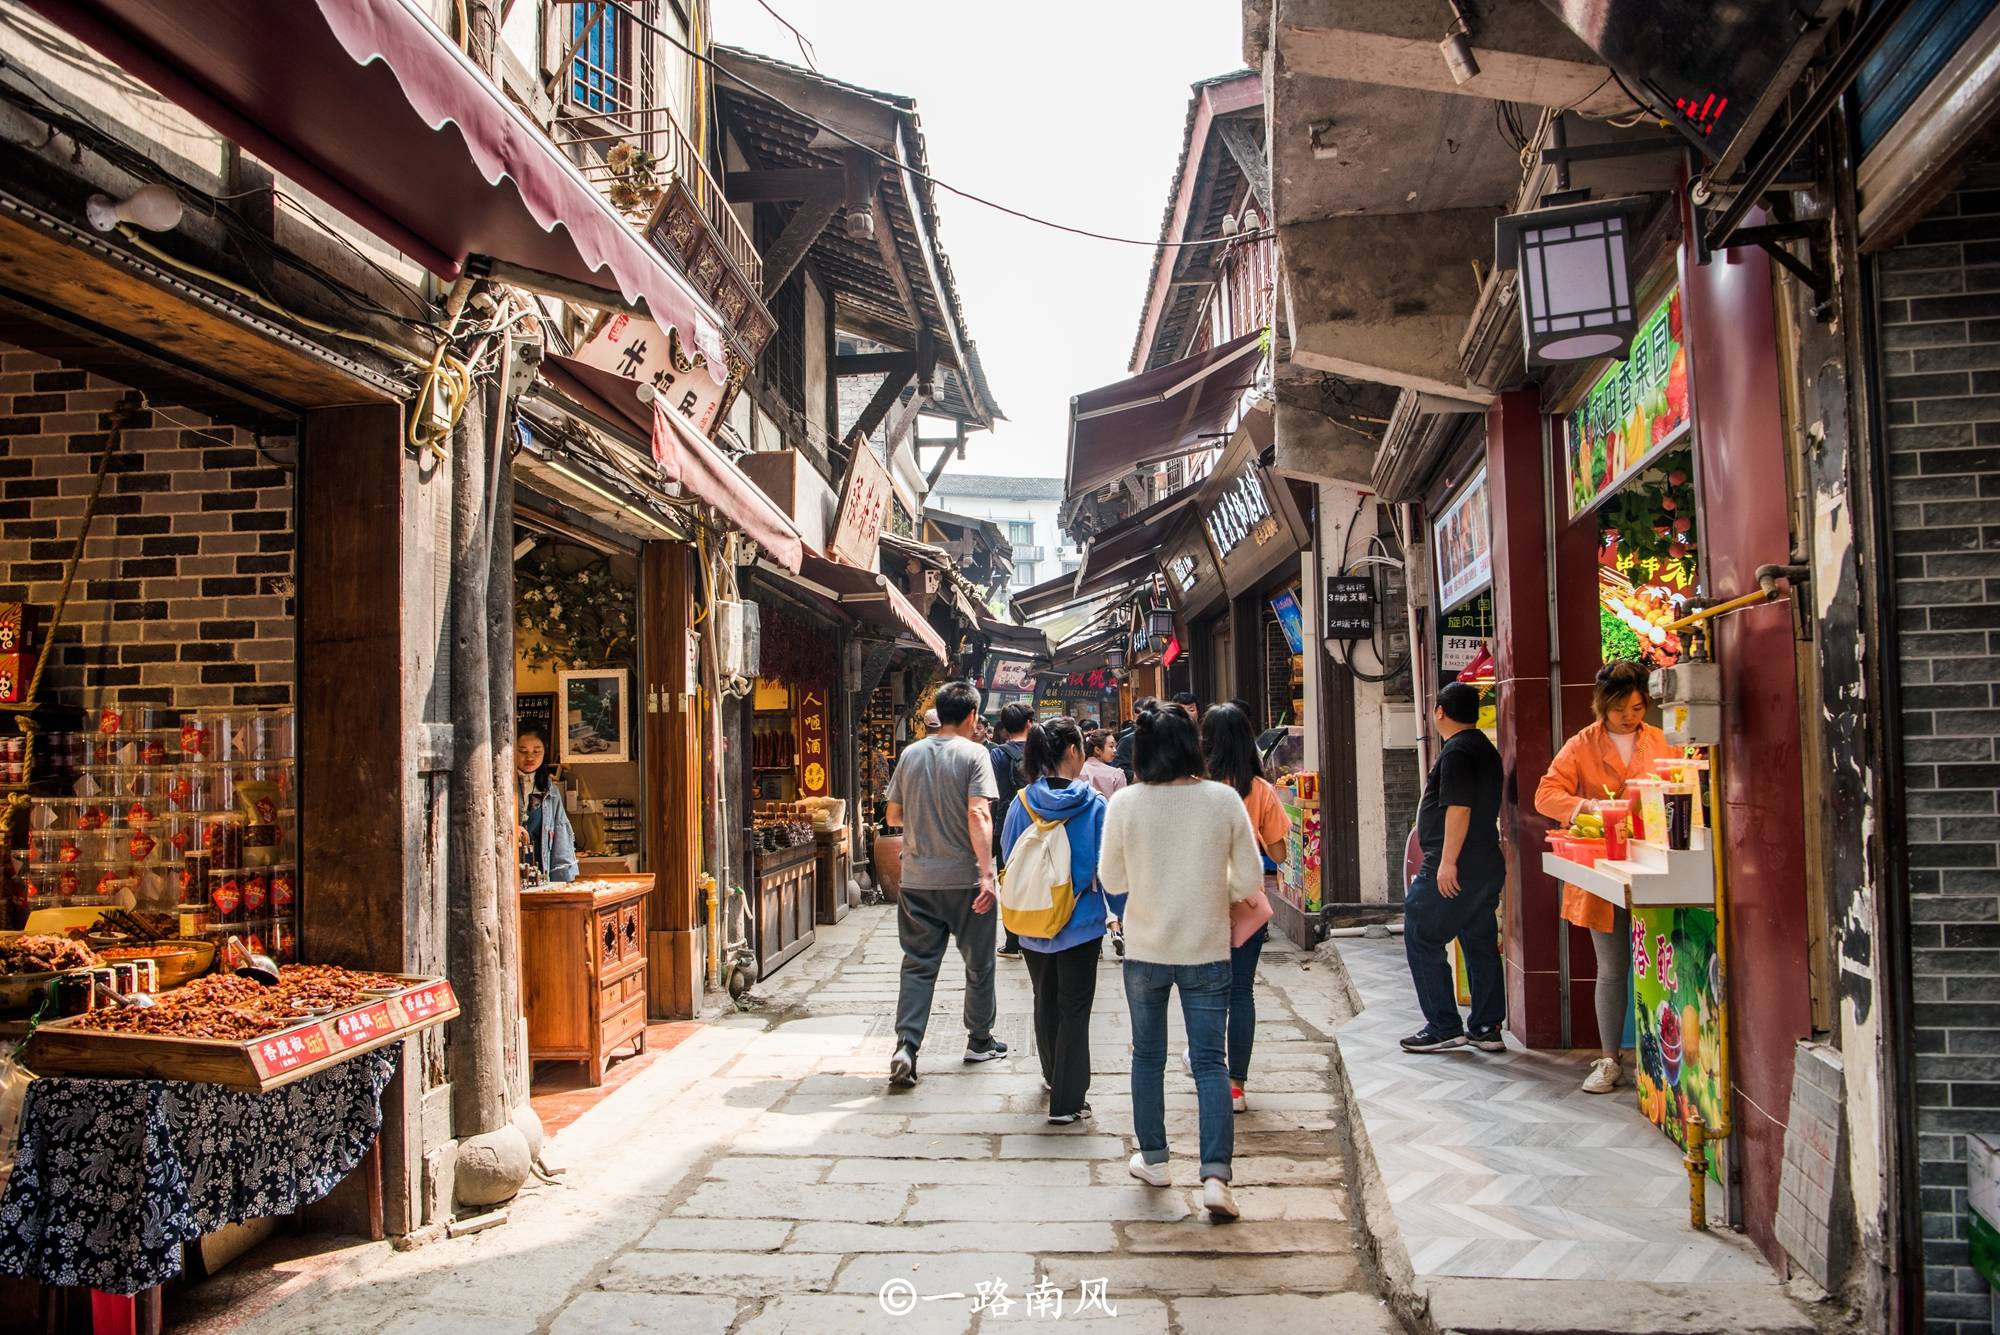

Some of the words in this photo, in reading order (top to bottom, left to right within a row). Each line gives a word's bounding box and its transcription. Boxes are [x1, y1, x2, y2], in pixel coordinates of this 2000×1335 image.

[1631, 916, 1678, 993] 搭配
[404, 991, 434, 1012] 香脆椒
[338, 1013, 374, 1035] 香脆椒
[263, 1036, 305, 1062] 香脆椒
